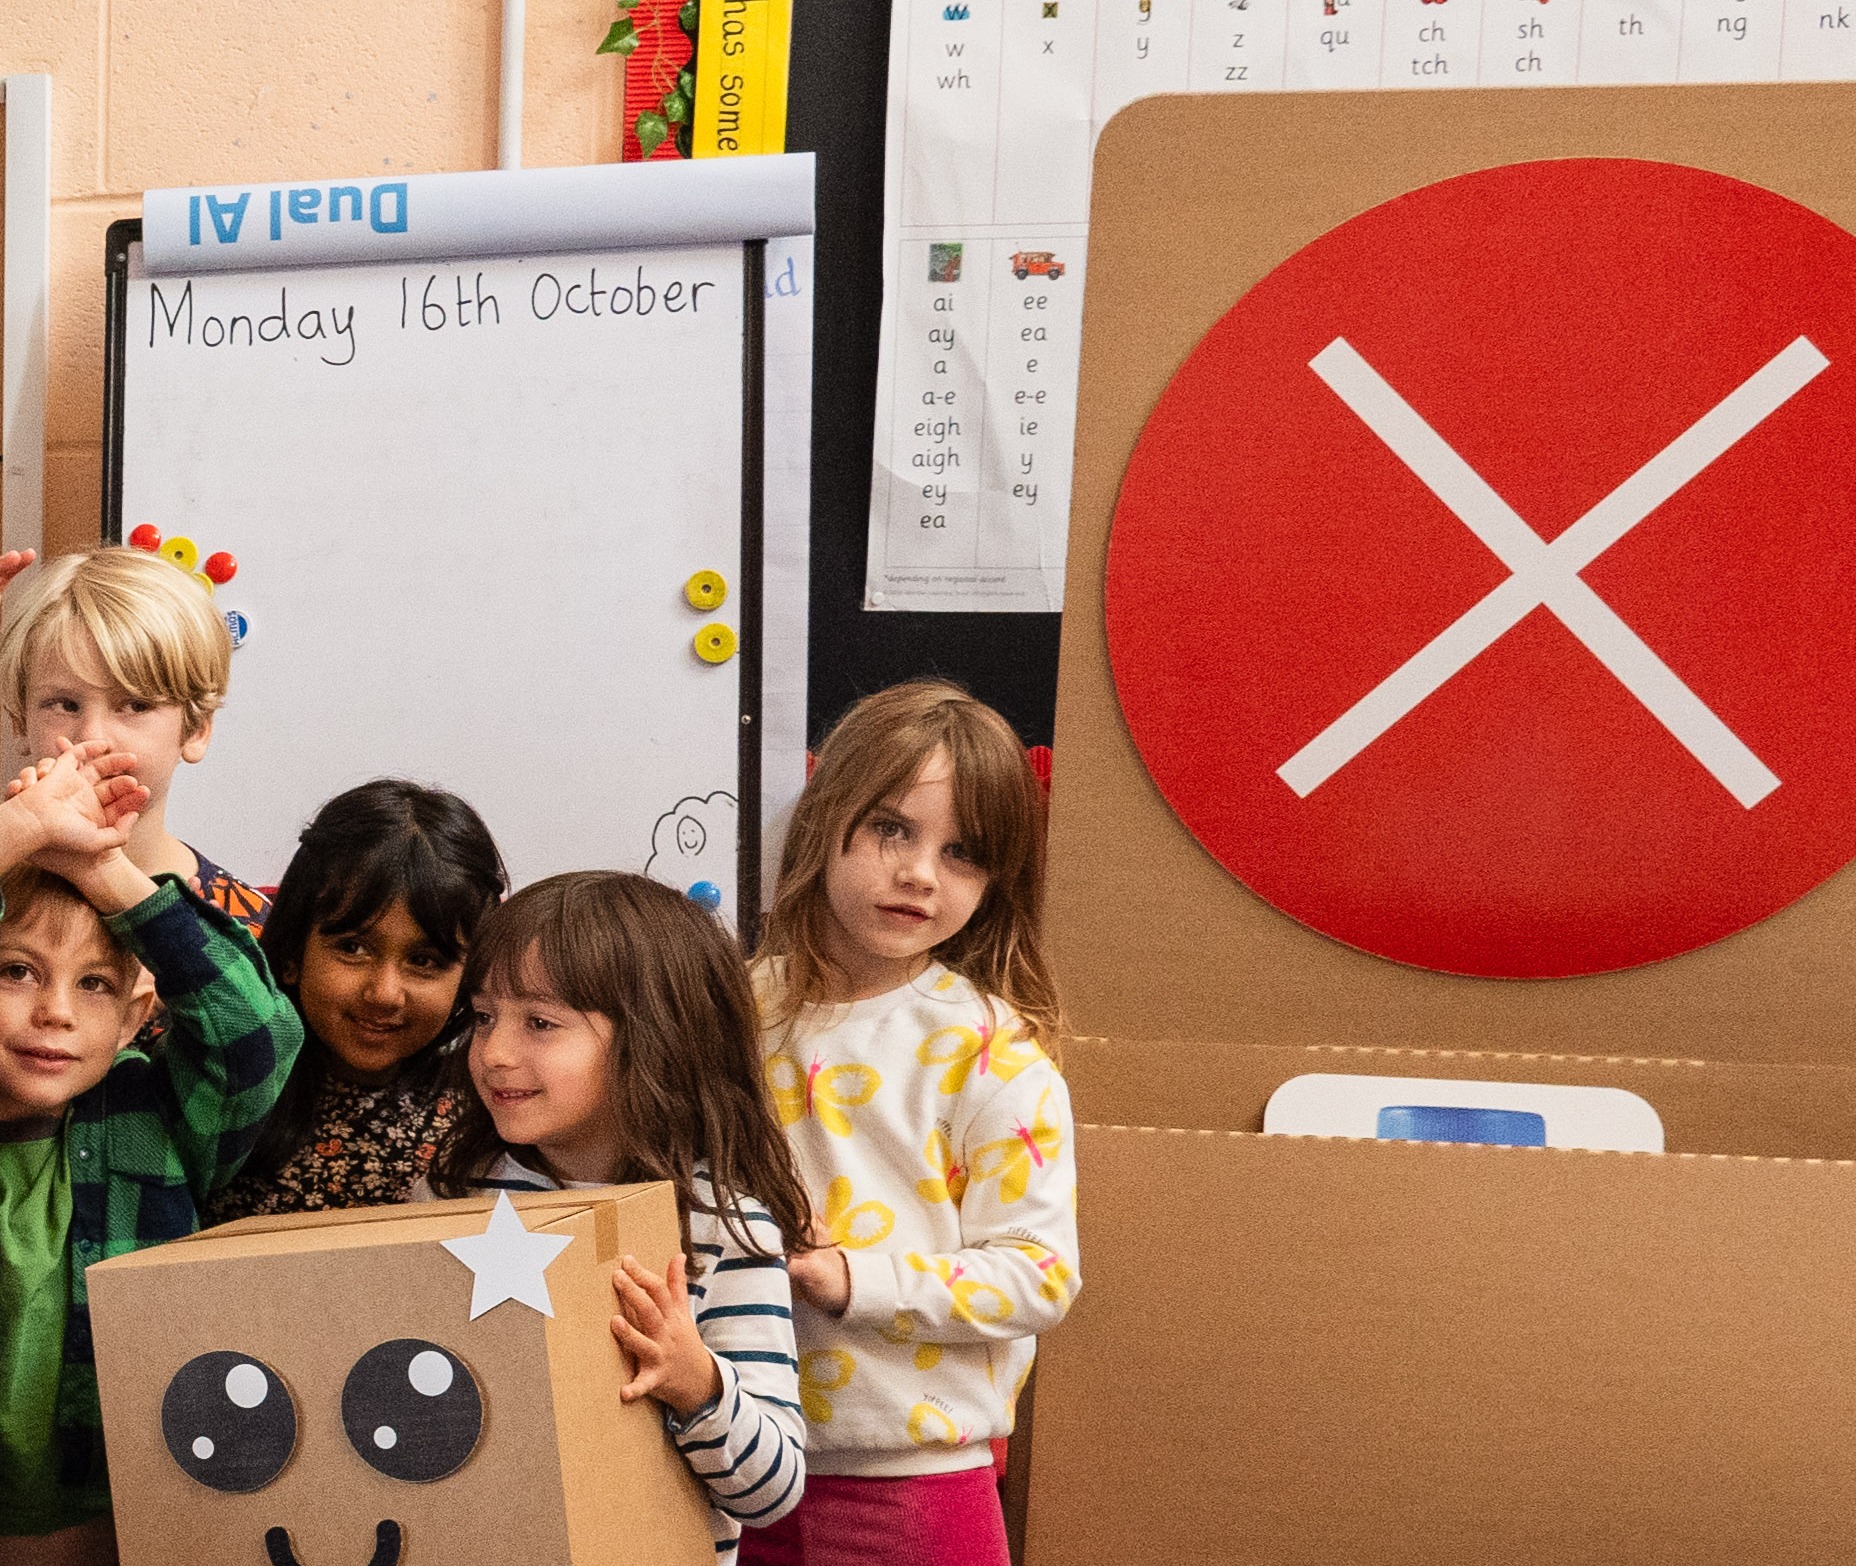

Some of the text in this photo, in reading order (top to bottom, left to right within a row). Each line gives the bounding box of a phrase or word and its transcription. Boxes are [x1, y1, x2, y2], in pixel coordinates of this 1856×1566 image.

[1517, 17, 1544, 39] sh
[1618, 14, 1645, 36] th
[1717, 15, 1747, 41] ng
[1818, 8, 1851, 29] nk
[1232, 33, 1244, 48] z
[1320, 29, 1350, 52] qu
[1418, 20, 1446, 42] ch
[945, 42, 964, 58] w
[1042, 39, 1055, 54] x
[1136, 35, 1150, 59] y
[1224, 65, 1248, 81] zz
[1411, 53, 1449, 76] tch
[1514, 51, 1542, 74] ch
[936, 71, 972, 90] wh
[270, 183, 409, 241] Dual
[933, 293, 954, 312] ai
[1023, 295, 1048, 310] ee
[149, 266, 715, 365] Monday 16th October
[928, 327, 955, 350] ay
[1020, 326, 1047, 342] ea
[933, 359, 948, 374] a
[1026, 357, 1038, 373] e
[922, 389, 956, 406] a-e
[1014, 388, 1047, 405] e-e
[913, 416, 961, 444] eigh
[1019, 418, 1039, 436] ie
[911, 448, 960, 475] aigh
[1020, 452, 1034, 475] y
[922, 484, 948, 506] ey
[1012, 482, 1038, 506] ey
[919, 513, 947, 530] ea
